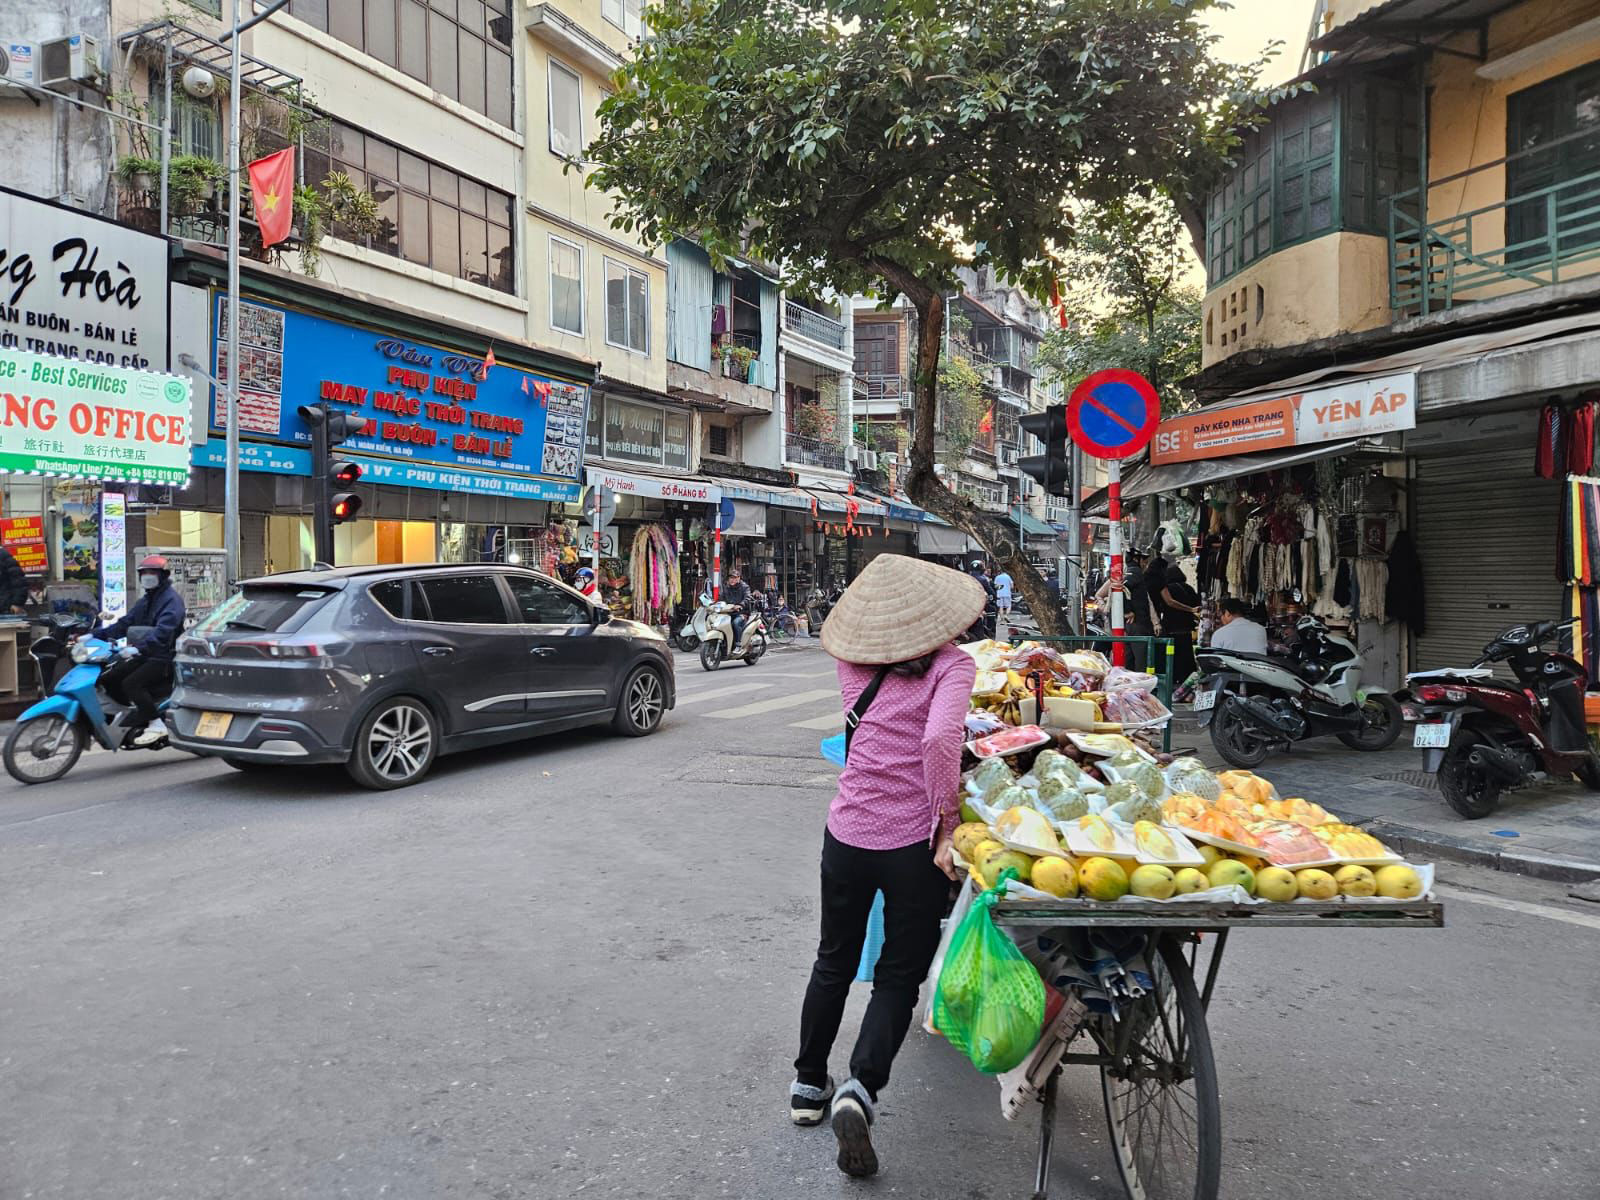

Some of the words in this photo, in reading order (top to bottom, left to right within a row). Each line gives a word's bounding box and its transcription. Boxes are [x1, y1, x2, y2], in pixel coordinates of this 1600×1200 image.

[53, 238, 141, 310] Hoà
[26, 311, 70, 333] BUÔN
[84, 322, 115, 342] BÁN
[122, 328, 137, 346] LẺ
[0, 329, 19, 348] ỜI
[26, 338, 78, 358] TRANG
[86, 349, 115, 366] CAO
[32, 362, 65, 386] Best
[67, 368, 128, 394] Services
[388, 366, 430, 394] PHỤ
[434, 376, 477, 401] KIỆN
[0, 393, 57, 431] NG
[69, 402, 185, 445] OFFICE
[320, 380, 368, 405] MAY
[374, 390, 421, 416] MẶC
[425, 401, 466, 424] THỜI
[470, 410, 524, 434] TRANG
[1212, 420, 1230, 431] KÉO
[1232, 417, 1251, 427] NHA
[1253, 411, 1284, 422] TRANG
[1313, 398, 1362, 425] YÊN
[1369, 386, 1407, 416] ẤP
[208, 454, 263, 467] HNG
[374, 464, 393, 477] VY
[407, 468, 435, 483] PHỤ
[439, 472, 470, 488] KIỆN
[505, 480, 541, 494] TRANG
[678, 486, 697, 498] HÀNG
